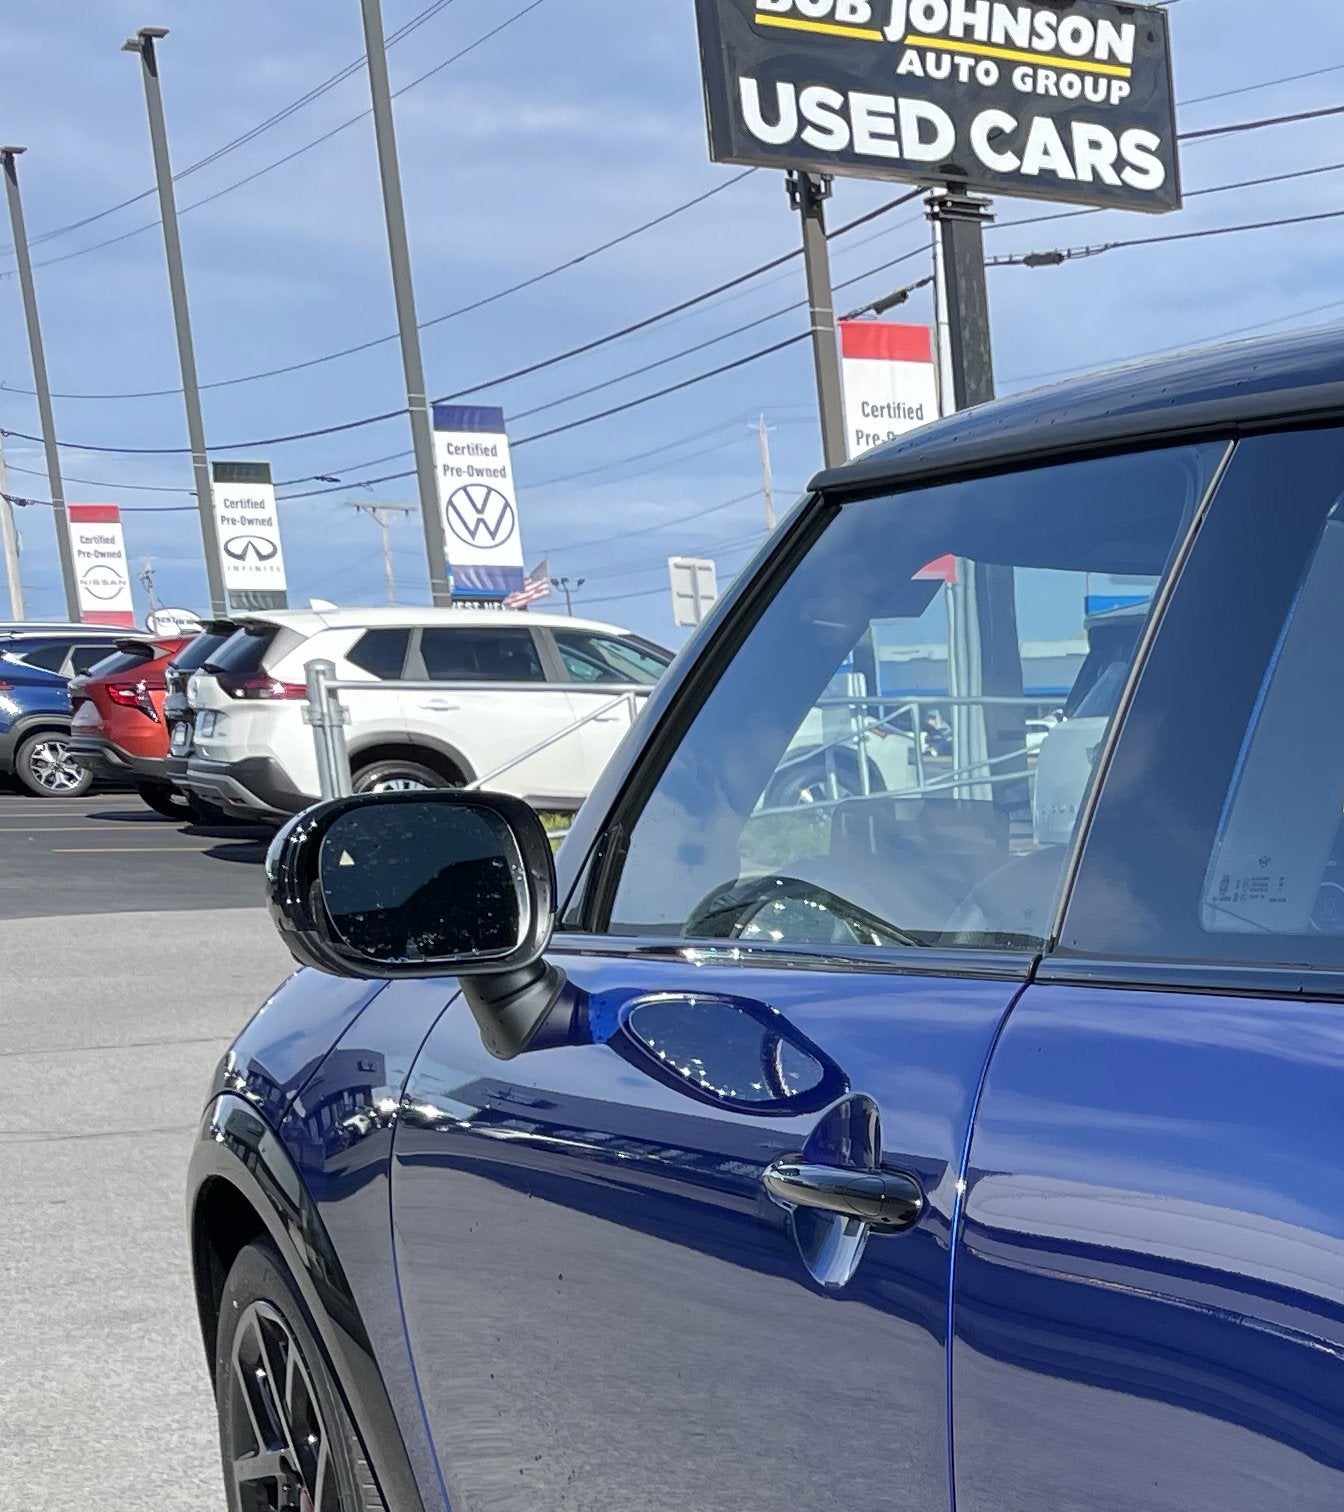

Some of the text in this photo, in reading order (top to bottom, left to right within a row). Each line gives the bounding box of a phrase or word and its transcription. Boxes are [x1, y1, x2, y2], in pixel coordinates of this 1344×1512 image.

[883, 0, 1135, 64] JOHNSON
[896, 49, 1132, 106] AUTO GROUP
[738, 76, 1167, 191] USED CARS
[861, 400, 925, 421] Certified
[855, 429, 897, 447] Pre-O
[446, 442, 498, 458] Certified
[442, 463, 508, 479] Pre-Owned
[223, 498, 266, 510] Certified
[220, 515, 273, 527] Pre-Owned
[79, 534, 116, 545] Certified
[77, 549, 122, 559] Pre-Owned
